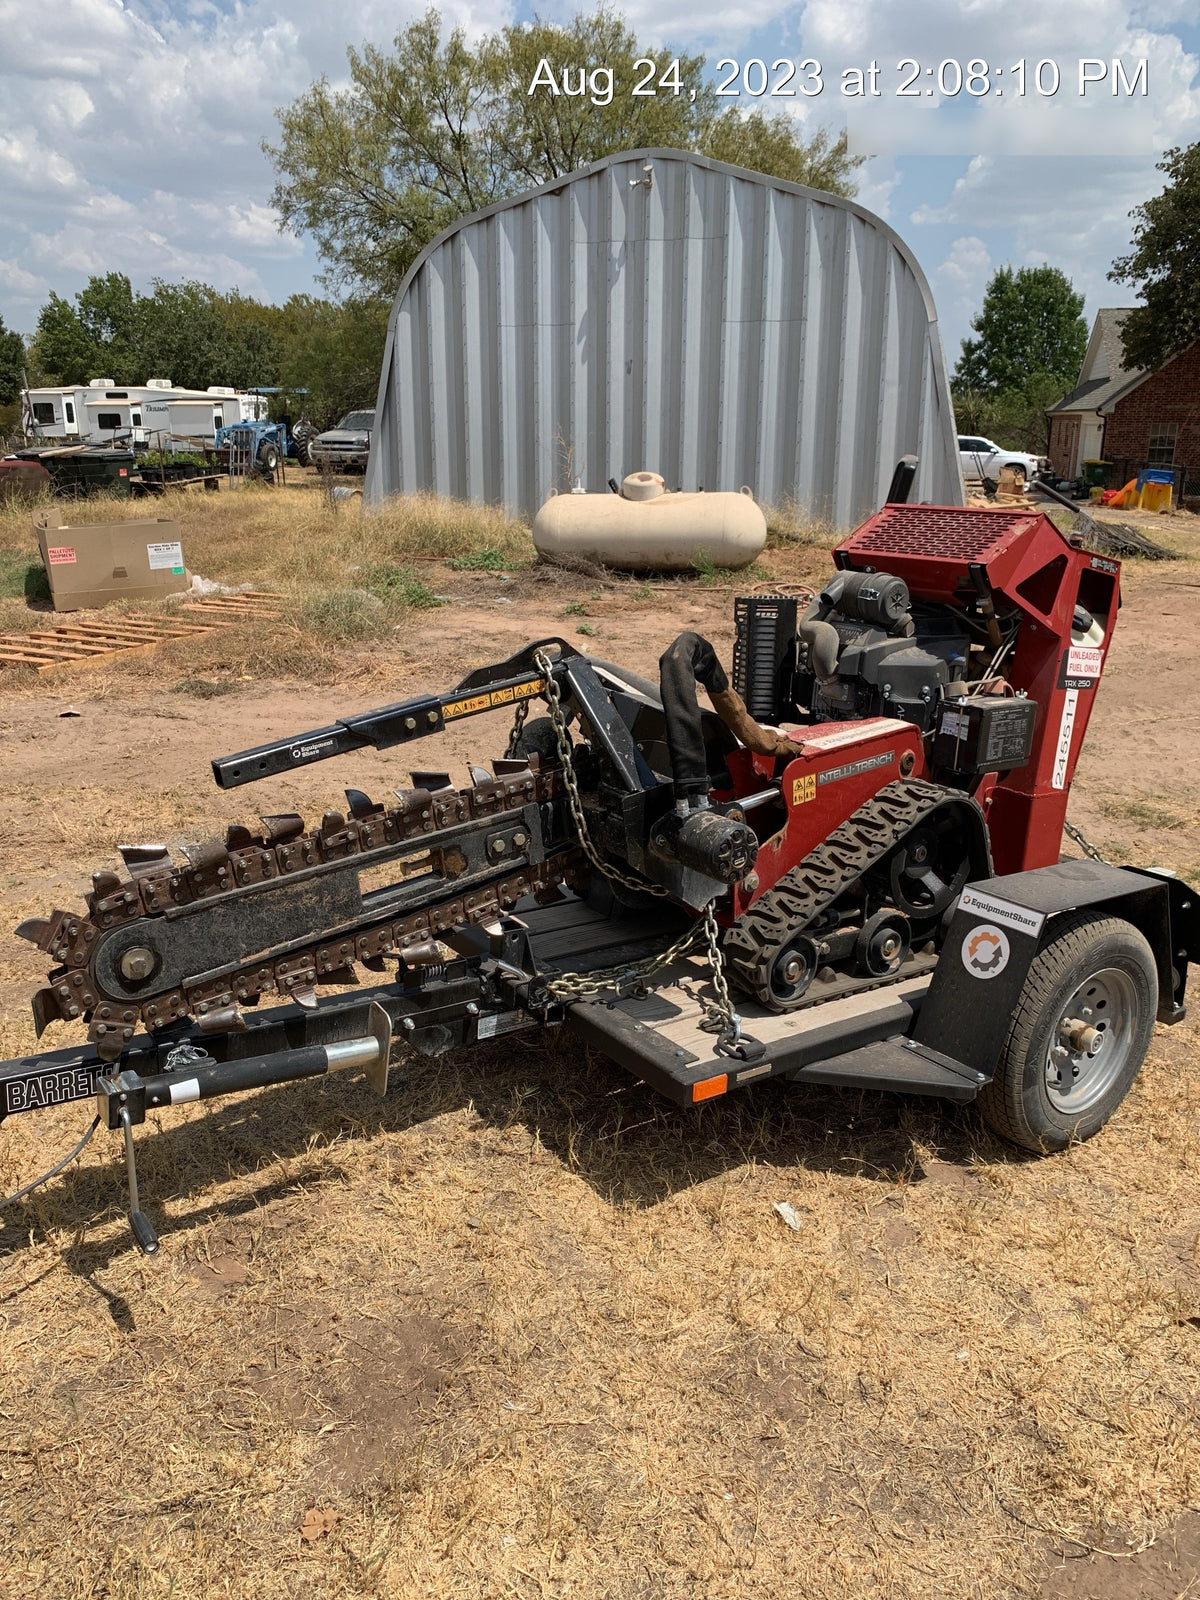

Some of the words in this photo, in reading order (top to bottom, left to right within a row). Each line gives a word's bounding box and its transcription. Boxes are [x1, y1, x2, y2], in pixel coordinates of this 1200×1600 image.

[1070, 650, 1100, 661] UNLEADED
[1069, 663, 1083, 673] FUEL
[1084, 664, 1099, 674] ONLY
[301, 740, 334, 752] Equipment
[1055, 698, 1076, 786] 245511
[301, 749, 320, 758] Share
[971, 898, 1038, 928] EquipmentShare
